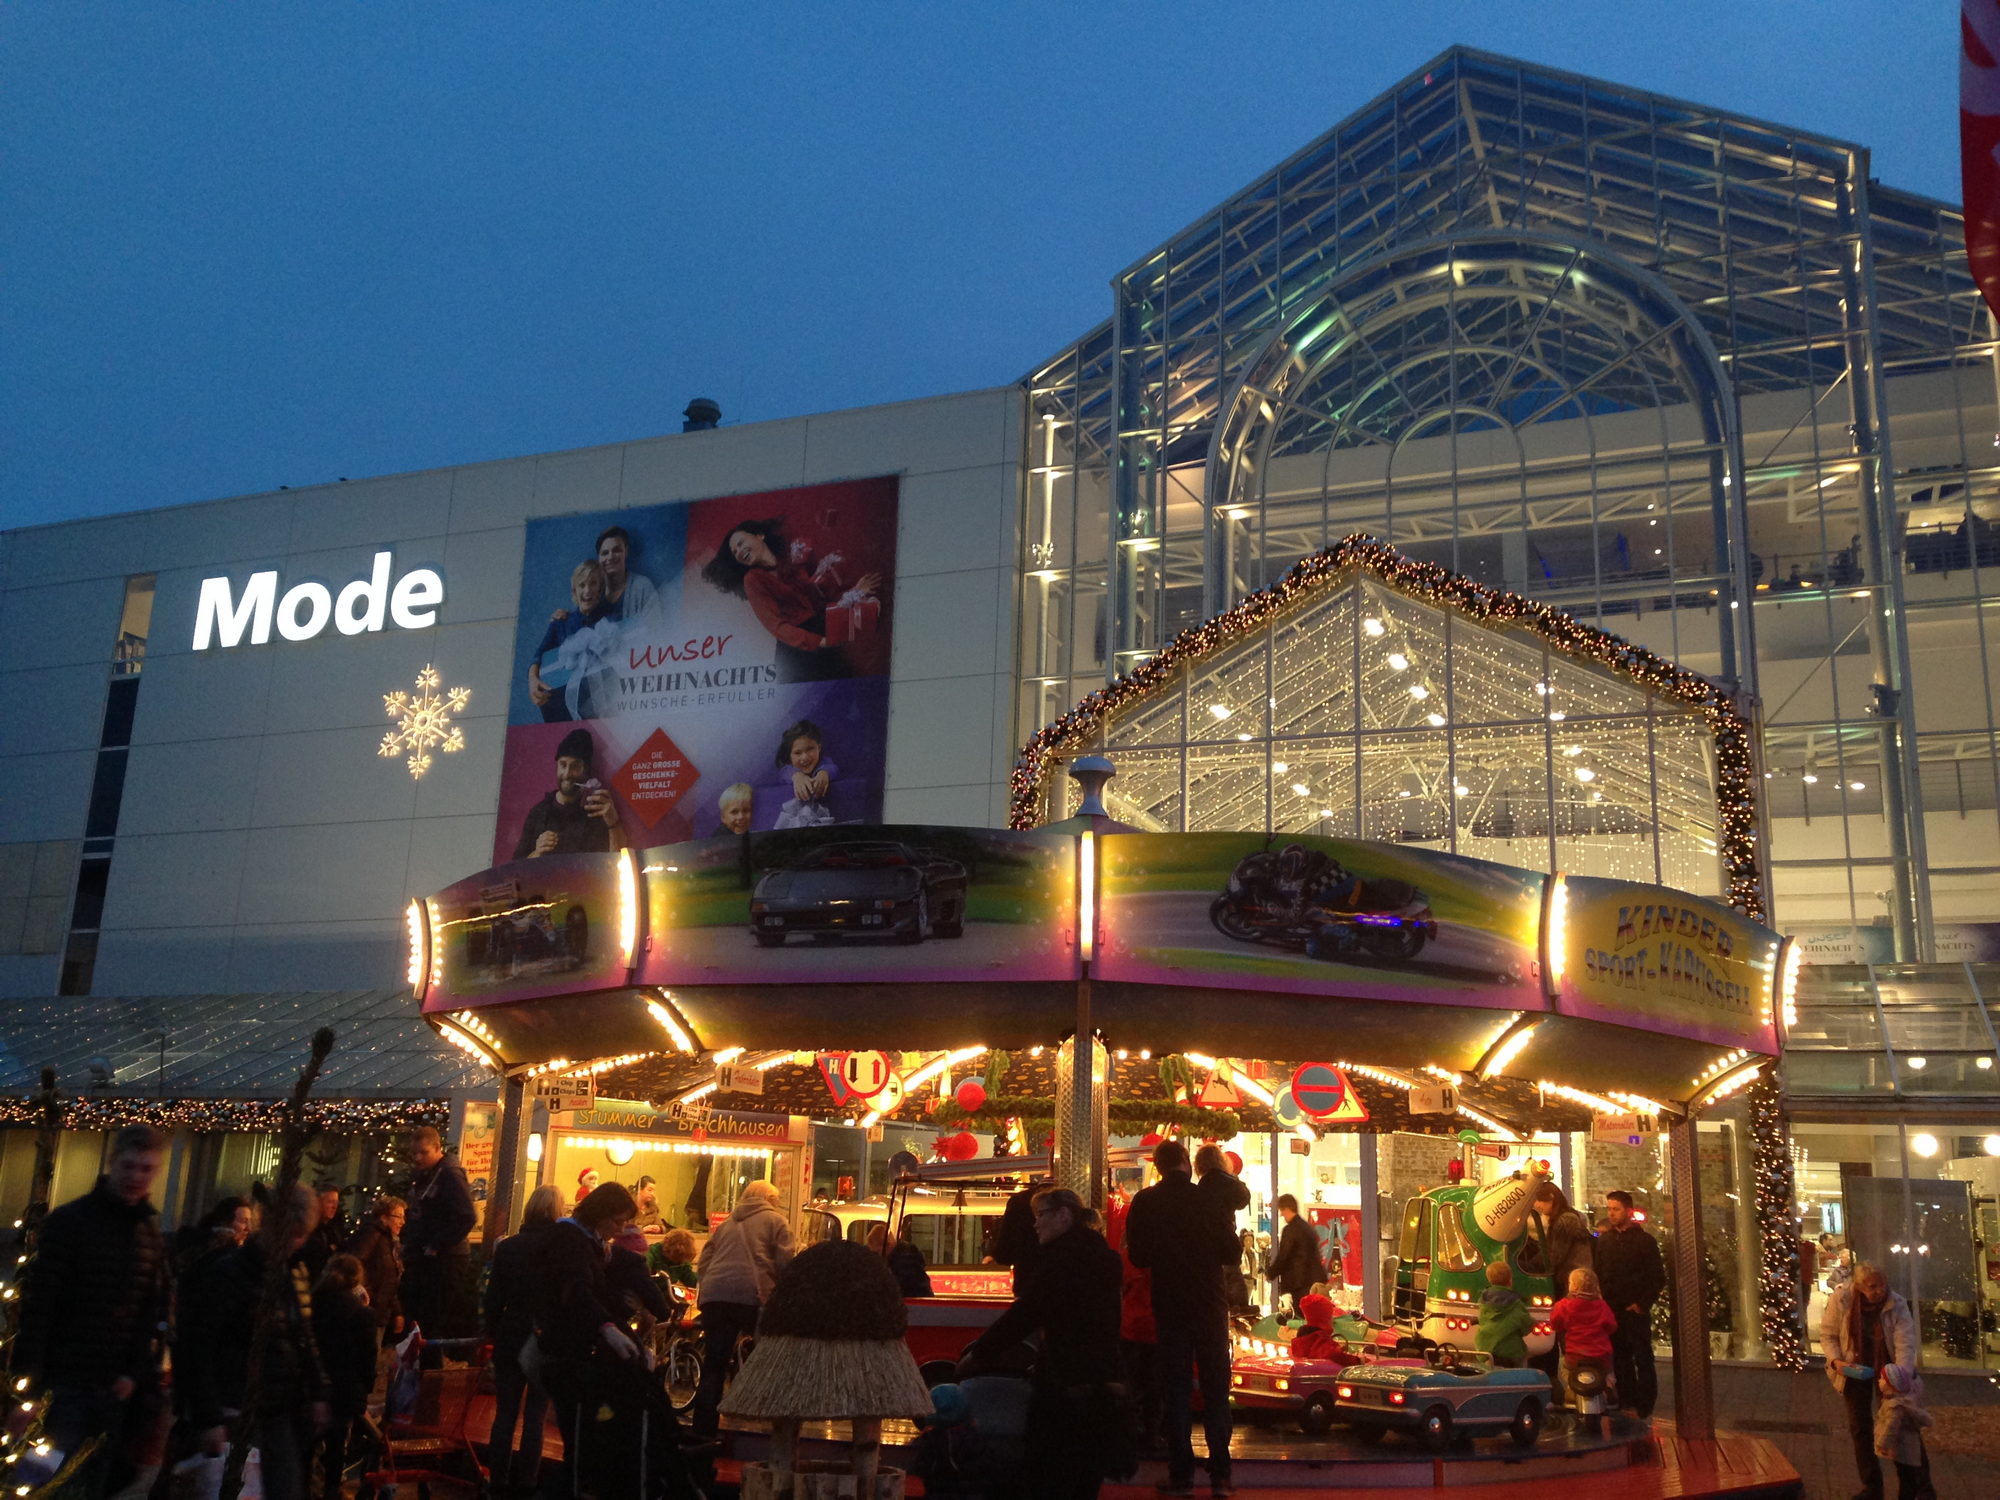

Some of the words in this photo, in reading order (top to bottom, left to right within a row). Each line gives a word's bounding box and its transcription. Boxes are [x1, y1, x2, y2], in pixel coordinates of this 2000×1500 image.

[192, 551, 443, 651] Mode
[629, 634, 733, 670] Unser
[619, 664, 777, 695] WEIHNACHTS
[651, 751, 663, 760] DIE
[632, 762, 651, 770] GANZ
[652, 760, 681, 769] GROSSE
[632, 770, 679, 780] GESCHENKE-
[638, 781, 671, 790] VIELFALT
[1614, 904, 1734, 980] KINDER
[721, 1066, 733, 1087] H
[549, 1098, 561, 1110] H
[1441, 1088, 1454, 1109] H
[672, 1103, 683, 1118] H
[579, 1109, 657, 1130] Stummer
[678, 1114, 785, 1137] Brchhausen
[1636, 1114, 1652, 1132] H
[1498, 1144, 1507, 1157] H
